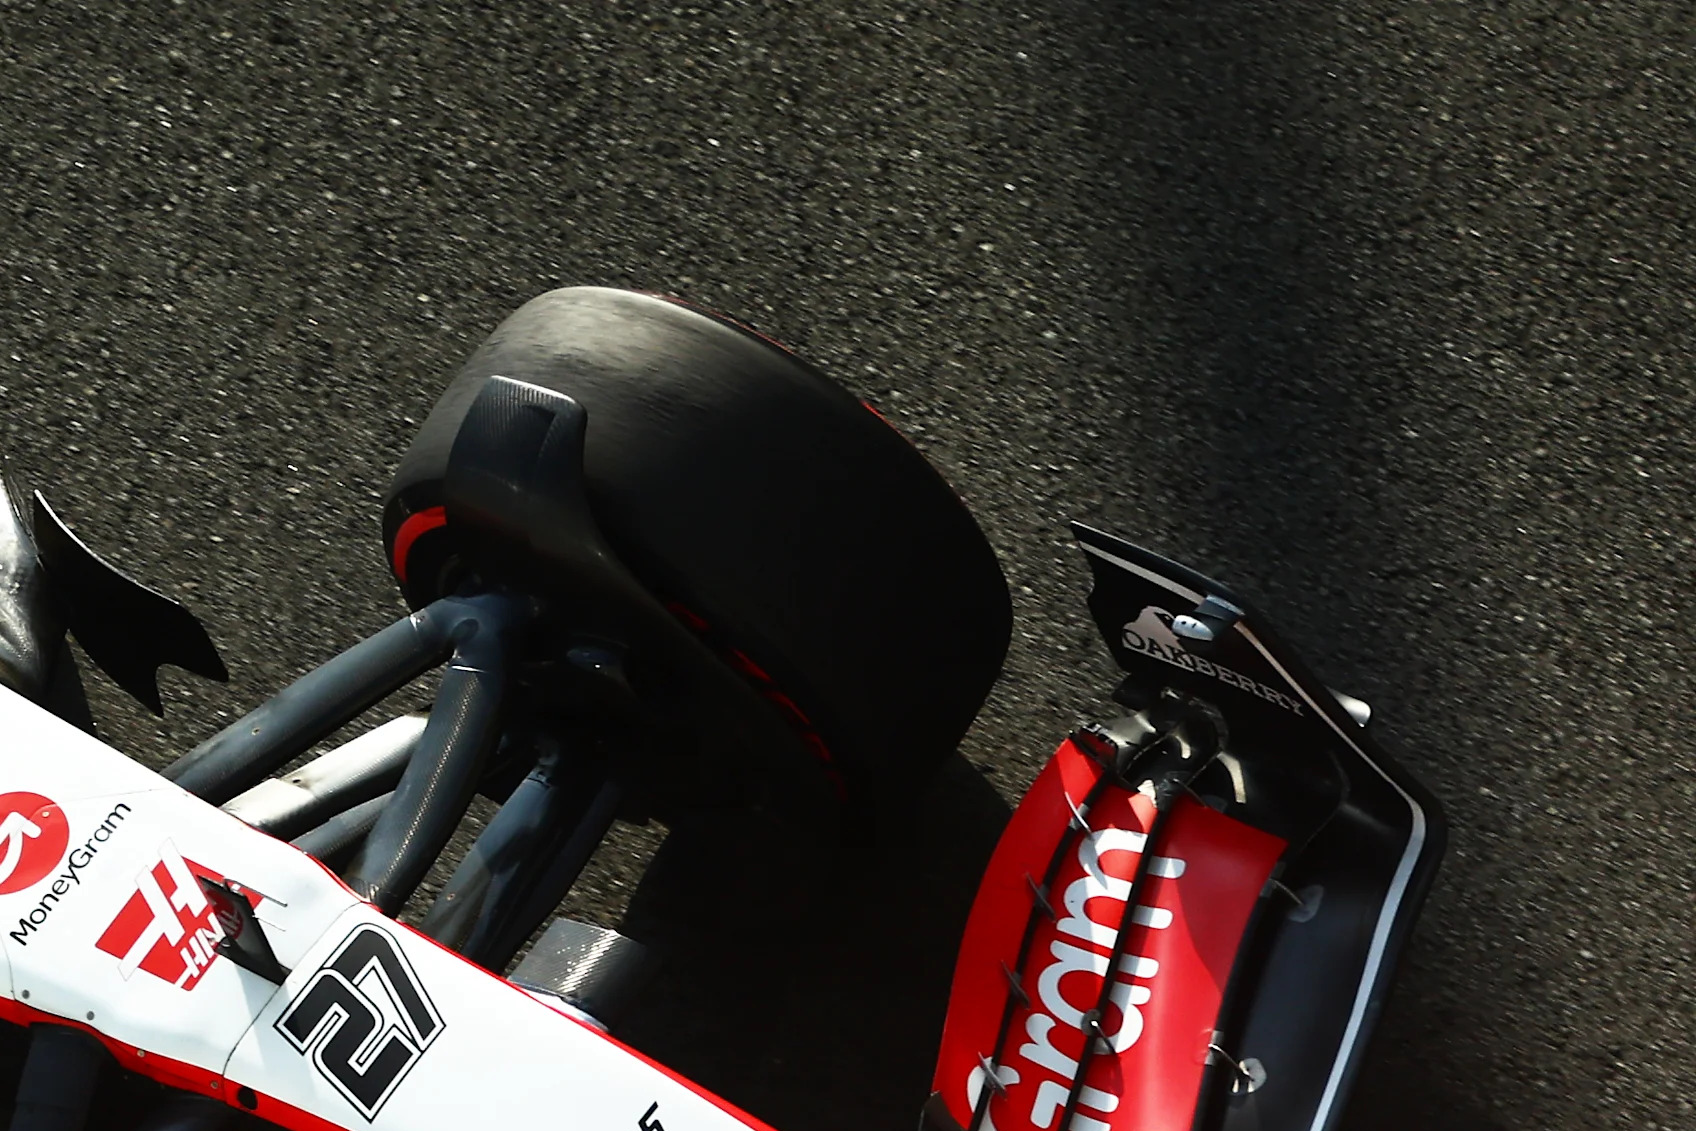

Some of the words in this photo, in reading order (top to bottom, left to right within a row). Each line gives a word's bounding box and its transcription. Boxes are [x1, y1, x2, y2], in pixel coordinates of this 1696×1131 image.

[1122, 629, 1305, 717] OAKBERRY
[9, 803, 132, 946] MoneyGram
[273, 922, 447, 1124] 27
